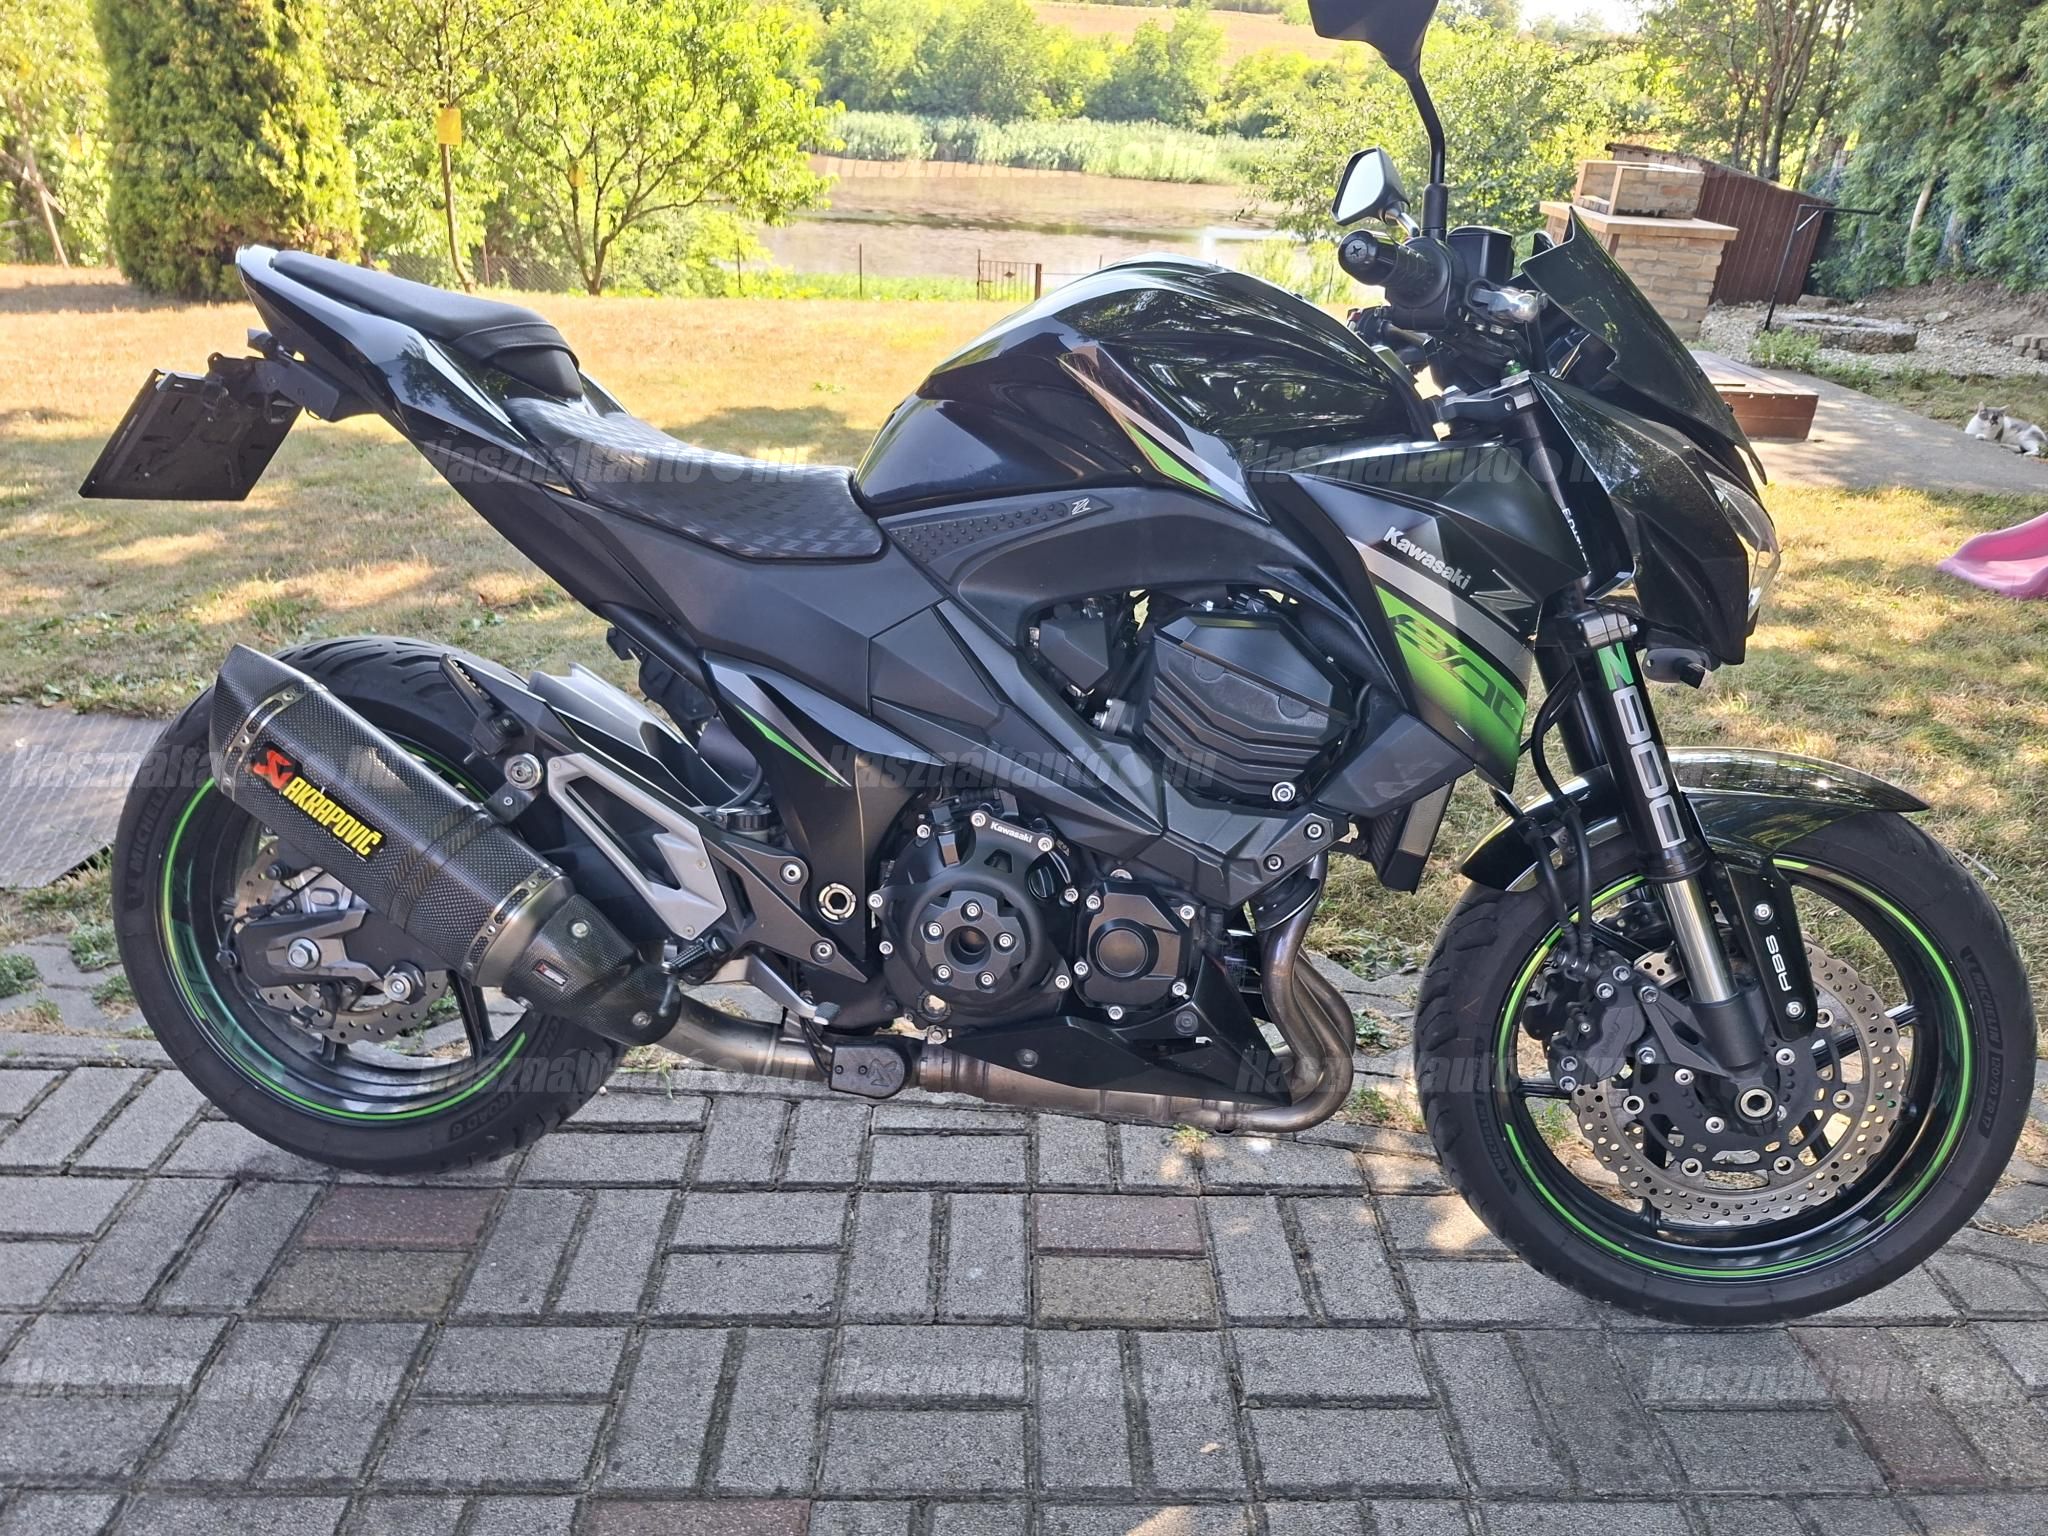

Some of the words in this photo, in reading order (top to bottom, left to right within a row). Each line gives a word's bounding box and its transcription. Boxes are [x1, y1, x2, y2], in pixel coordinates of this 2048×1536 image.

[1383, 526, 1472, 591] Kawasaki
[990, 821, 1033, 844] Kawasaki
[1765, 934, 1792, 992] ABS
